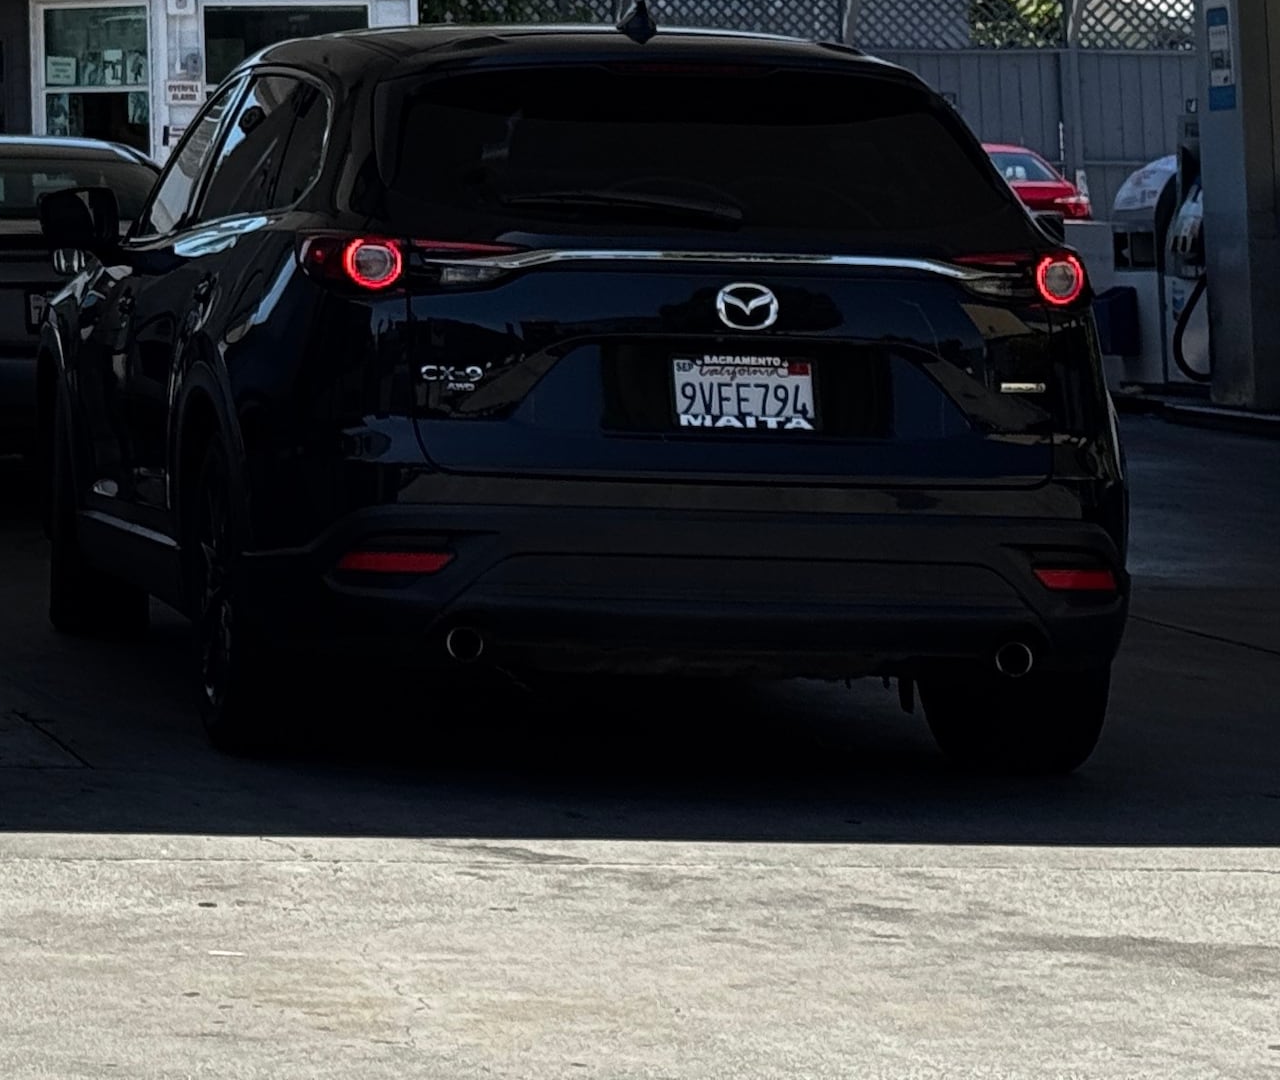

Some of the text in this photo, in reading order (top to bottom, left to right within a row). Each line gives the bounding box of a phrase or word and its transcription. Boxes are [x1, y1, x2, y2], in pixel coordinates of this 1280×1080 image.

[703, 355, 781, 366] SACRAMENTO
[420, 364, 484, 381] CX-9
[681, 382, 809, 418] 9VFE794
[679, 414, 815, 431] MAITA
